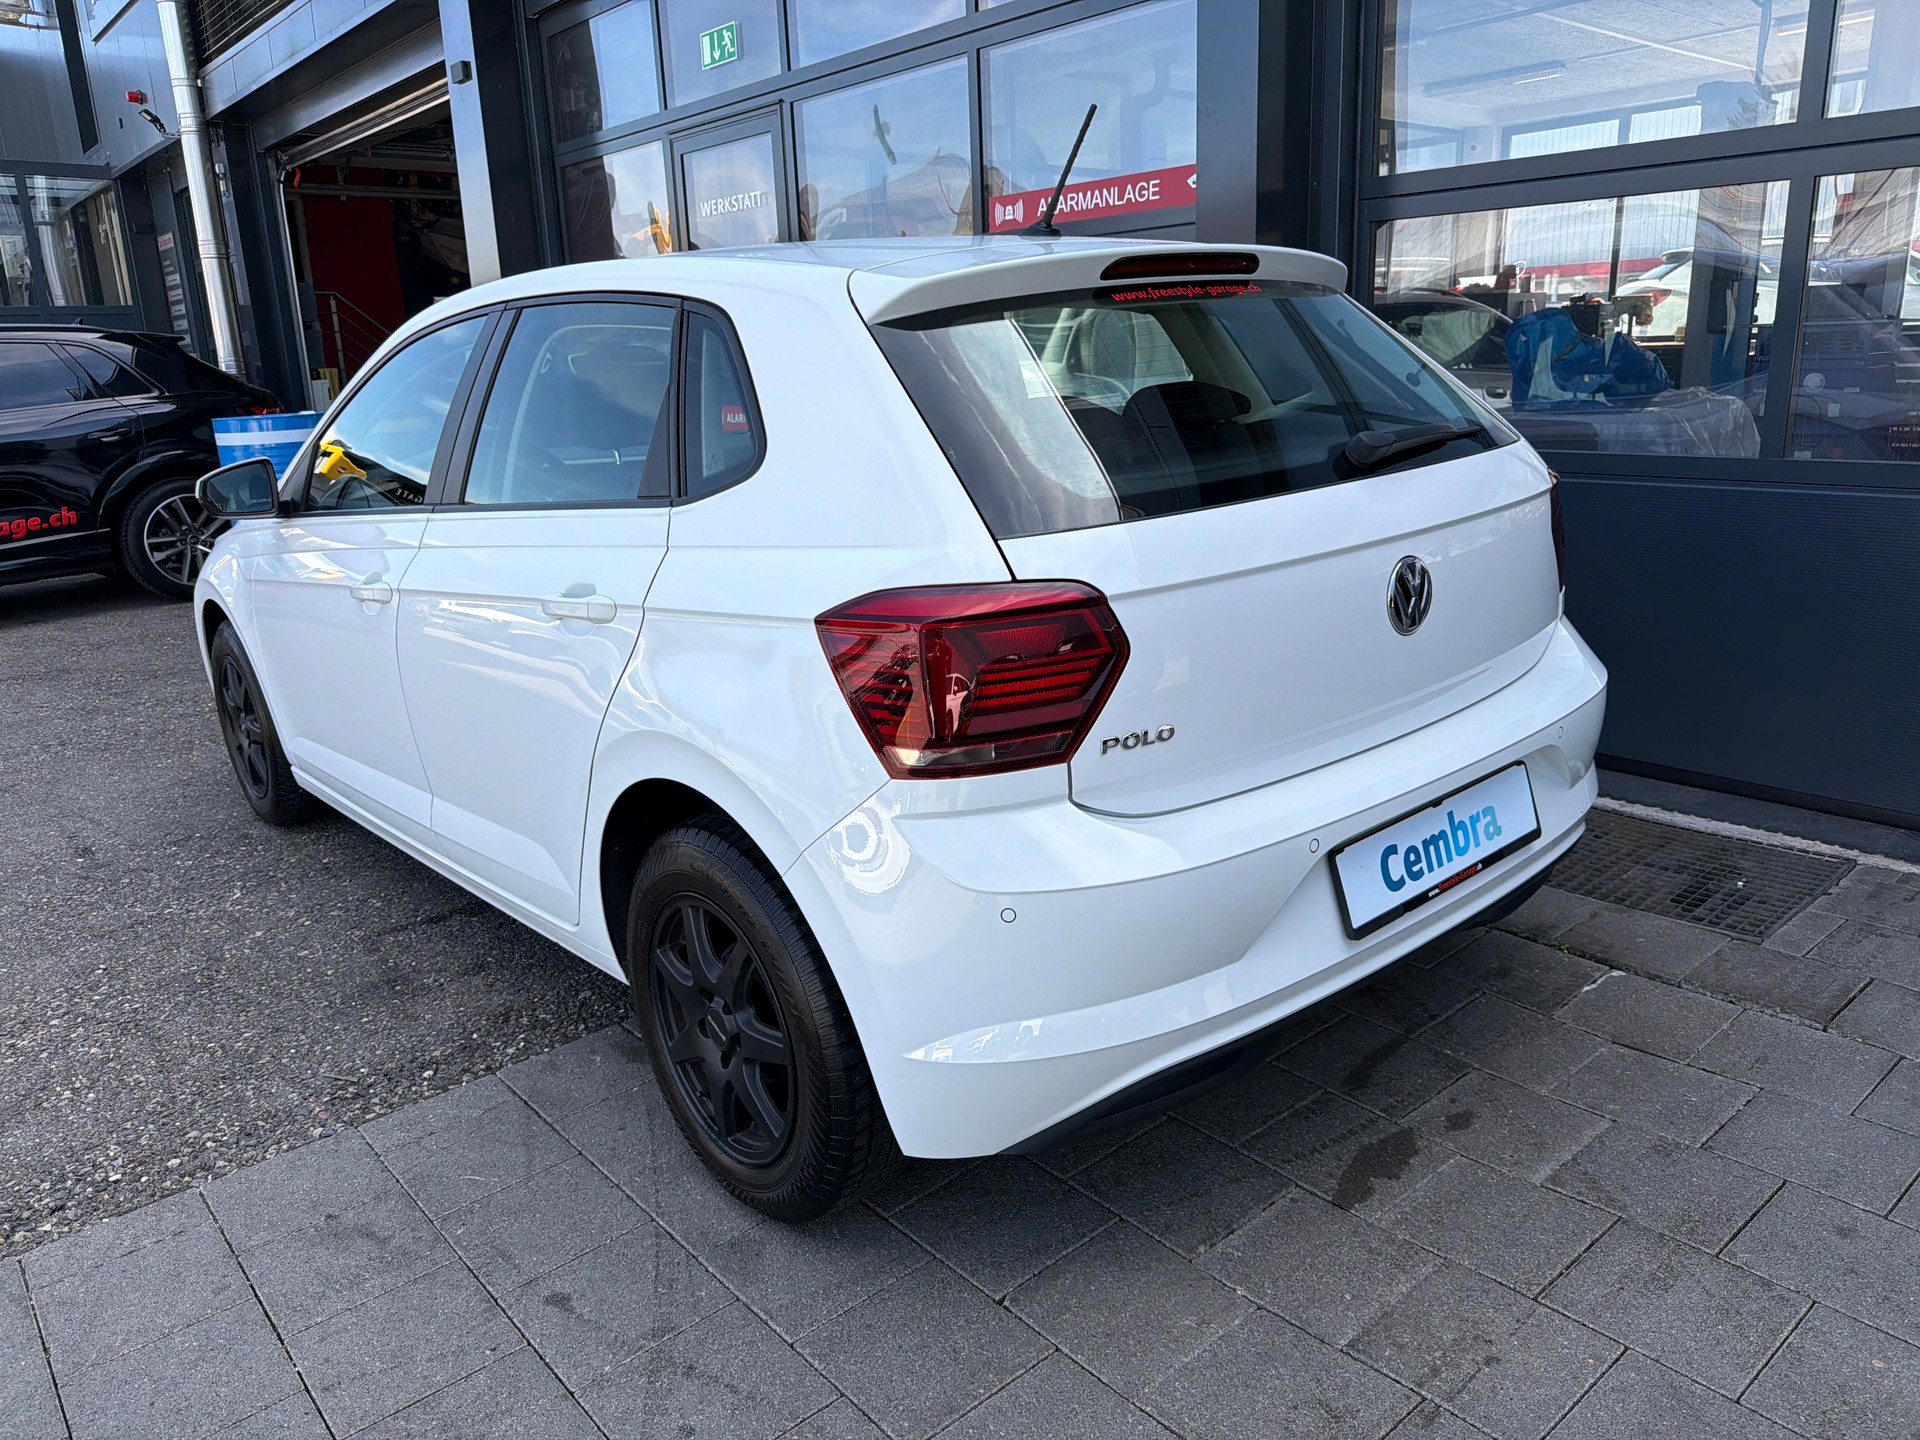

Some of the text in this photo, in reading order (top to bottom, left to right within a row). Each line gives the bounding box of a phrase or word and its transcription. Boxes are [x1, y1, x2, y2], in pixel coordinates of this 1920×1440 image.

[700, 190, 762, 217] WERKSTATT
[1111, 284, 1263, 301] www.freestyle-garage.ch
[0, 506, 77, 539] age.ch
[1100, 724, 1175, 755] POLO
[1380, 805, 1502, 893] Cembra
